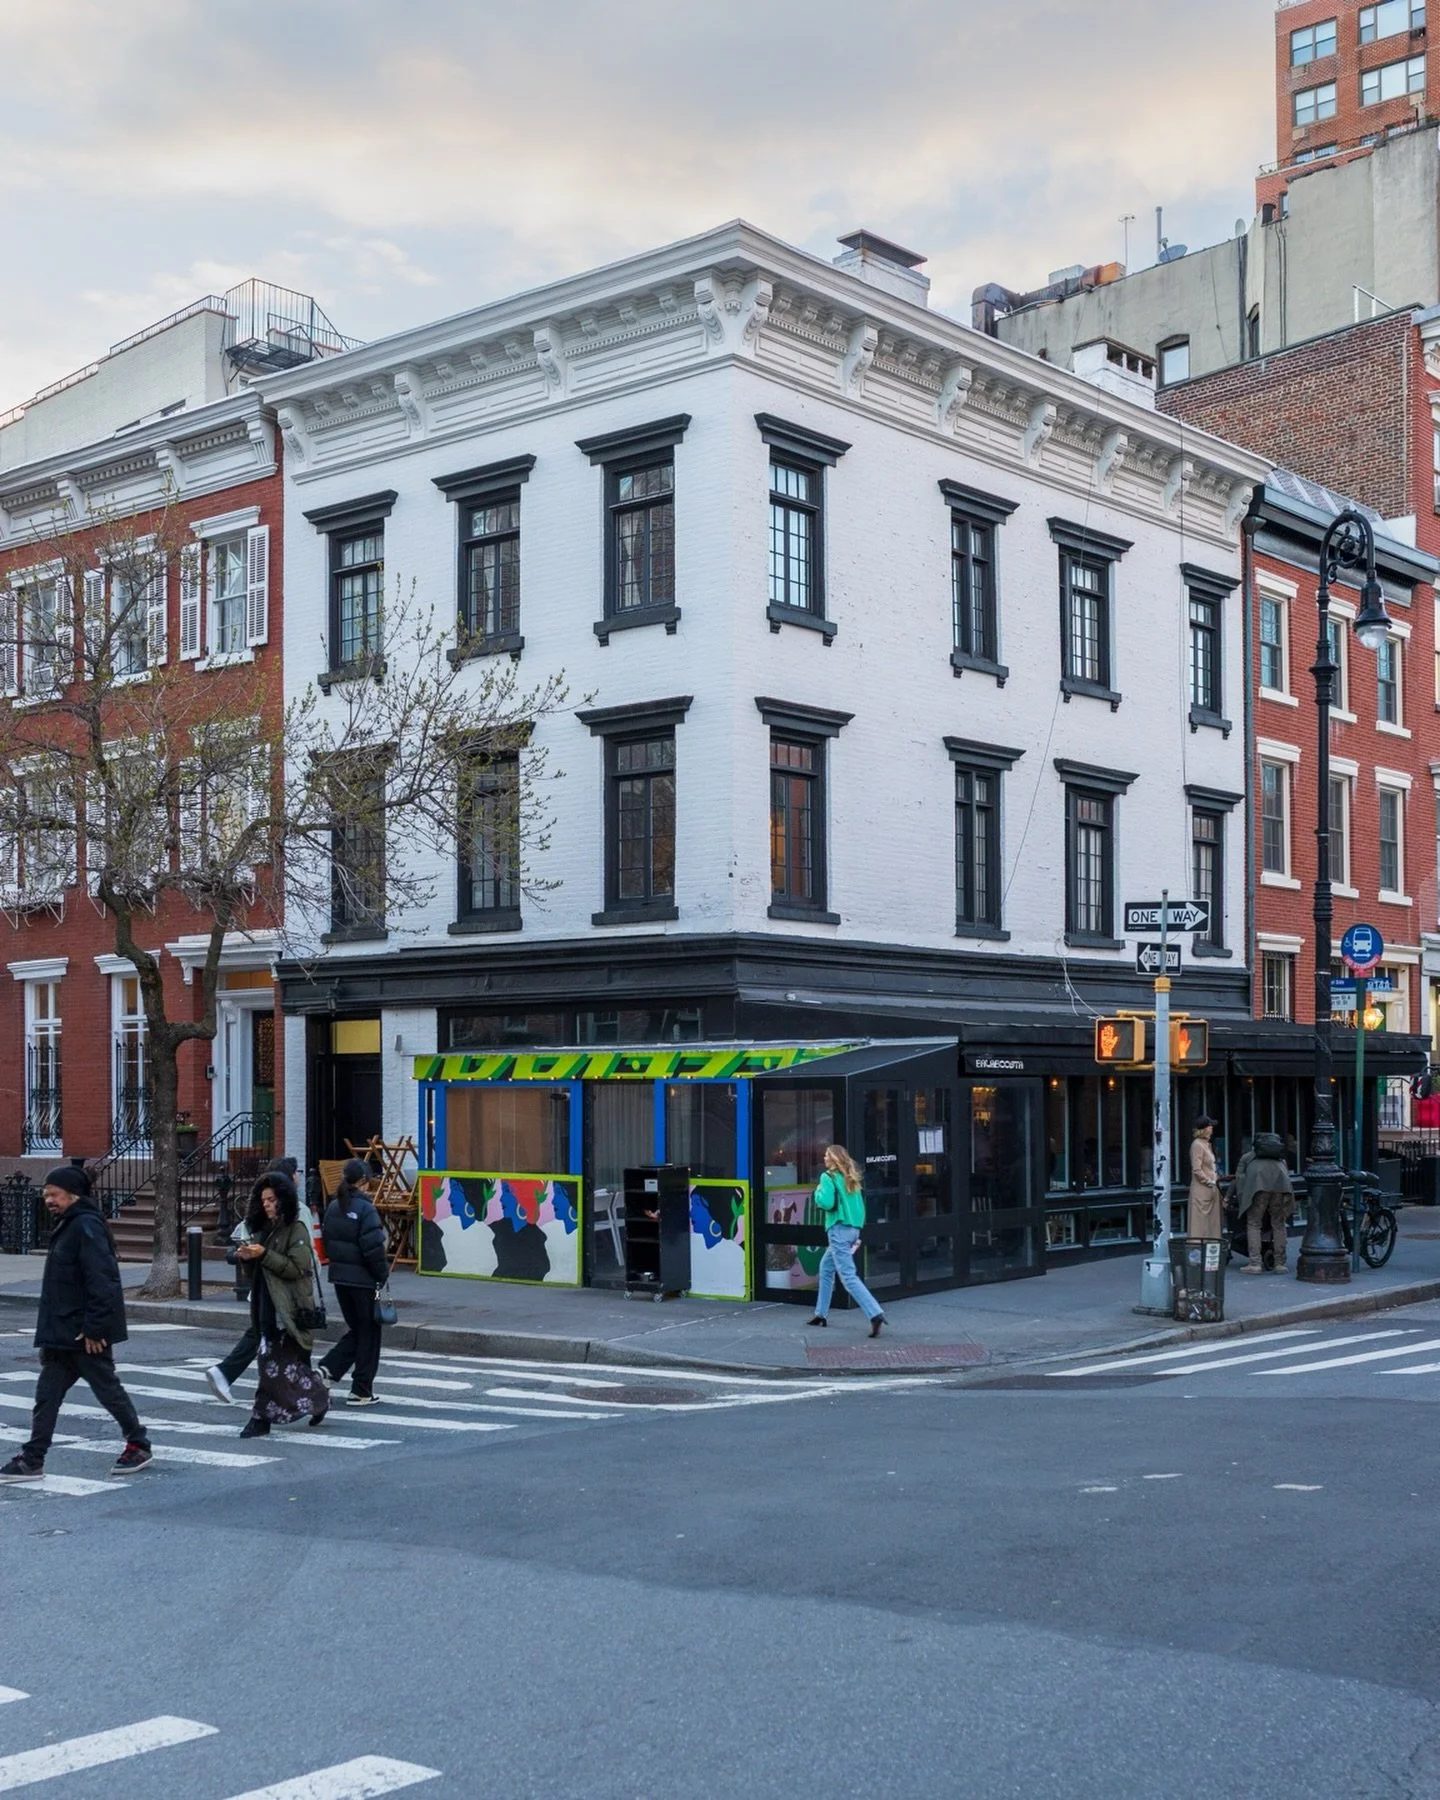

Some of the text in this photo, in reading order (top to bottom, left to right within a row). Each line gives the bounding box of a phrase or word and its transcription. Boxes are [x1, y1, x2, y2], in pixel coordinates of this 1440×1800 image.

[1131, 910, 1199, 923] ONE WAY
[1143, 951, 1157, 965] ONE
